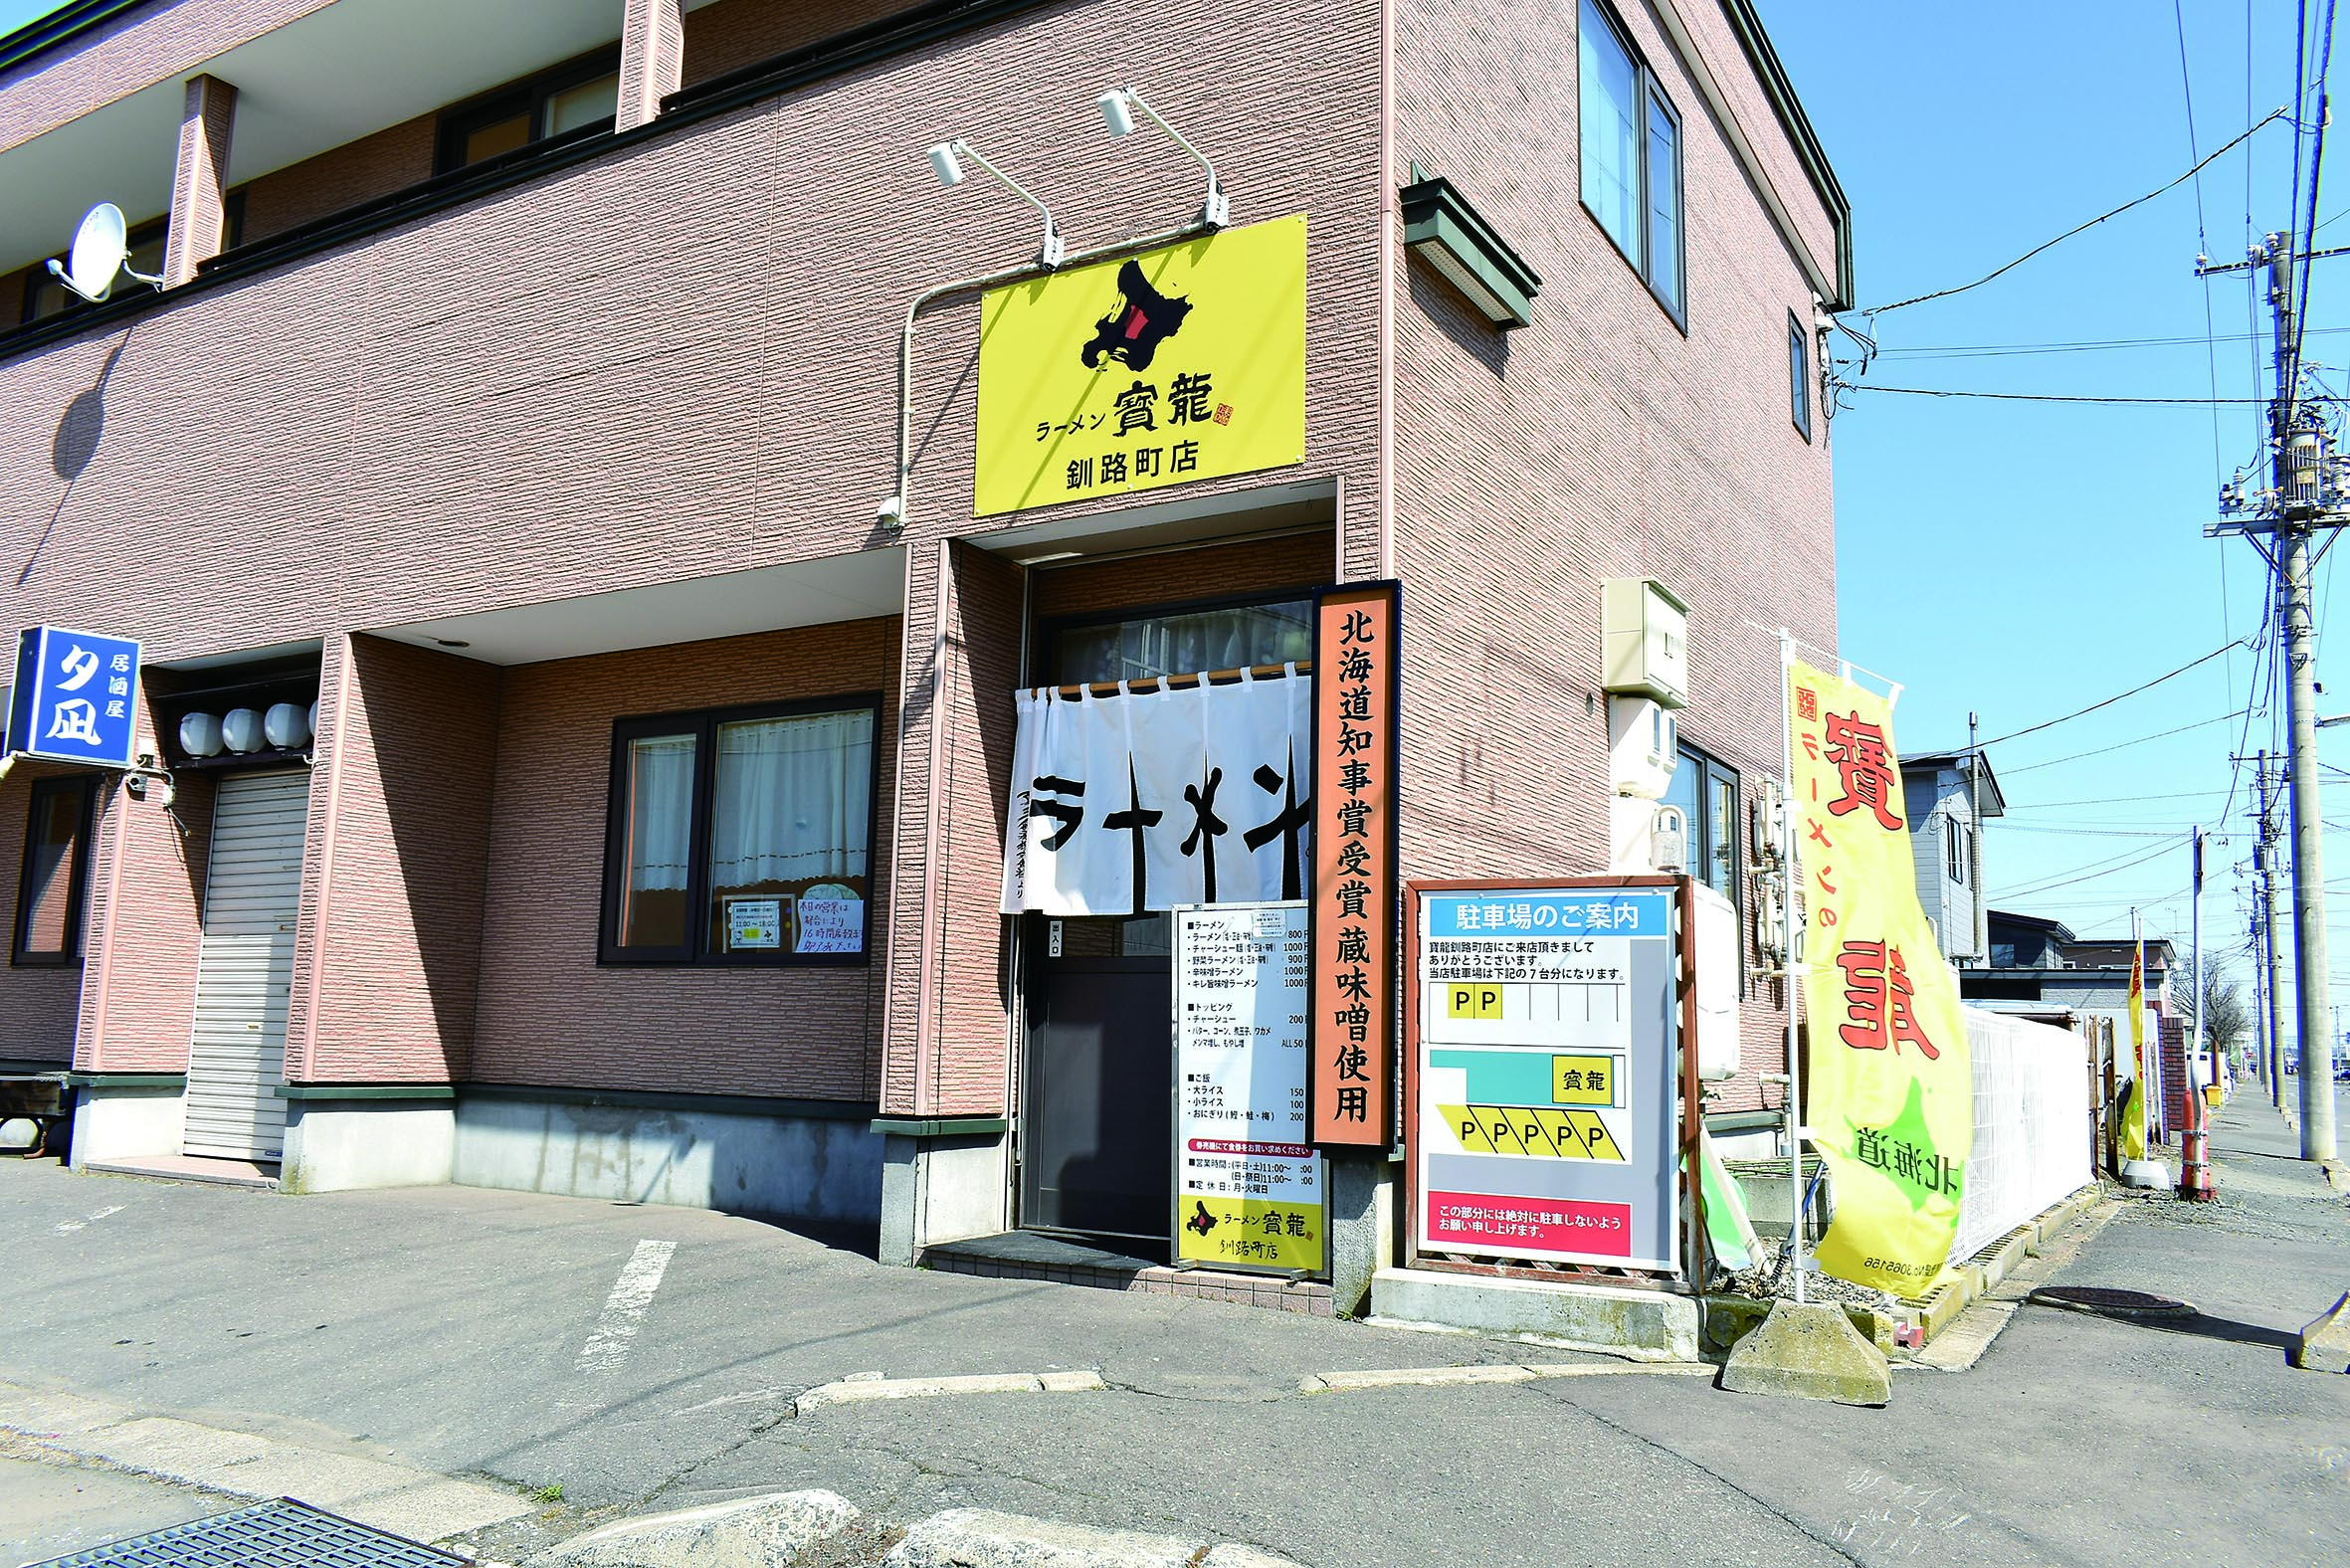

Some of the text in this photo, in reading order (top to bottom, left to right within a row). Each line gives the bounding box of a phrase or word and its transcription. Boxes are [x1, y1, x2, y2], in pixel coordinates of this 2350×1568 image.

[1037, 413, 1105, 442] ラーメン
[1067, 440, 1199, 490] 釧路町店
[44, 645, 101, 746] 夕凪
[104, 654, 129, 718] 居酒屋
[1333, 609, 1375, 1123] 北海道知事賞受賞蔵味噌使用
[1457, 903, 1639, 929] 駐車場のご案内
[1429, 955, 1542, 967] ありがとうございます。
[1196, 1003, 1233, 1012] トッピング
[1456, 992, 1495, 1010] P P
[1193, 1015, 1237, 1024] チャーシュー
[1196, 1074, 1210, 1083] ご飯
[1193, 1085, 1304, 1097] 大ライス 150
[1193, 1097, 1304, 1109] 小ライス 100
[1290, 1112, 1304, 1121] 200
[1462, 1121, 1603, 1146] P P P P P
[1225, 1214, 1261, 1225] ラーメン
[1440, 1205, 1622, 1230] この部分には絶対に駐車しないよう
[1439, 1219, 1545, 1239] お願い申し上げます。
[1220, 1239, 1278, 1260] 釧路町店
